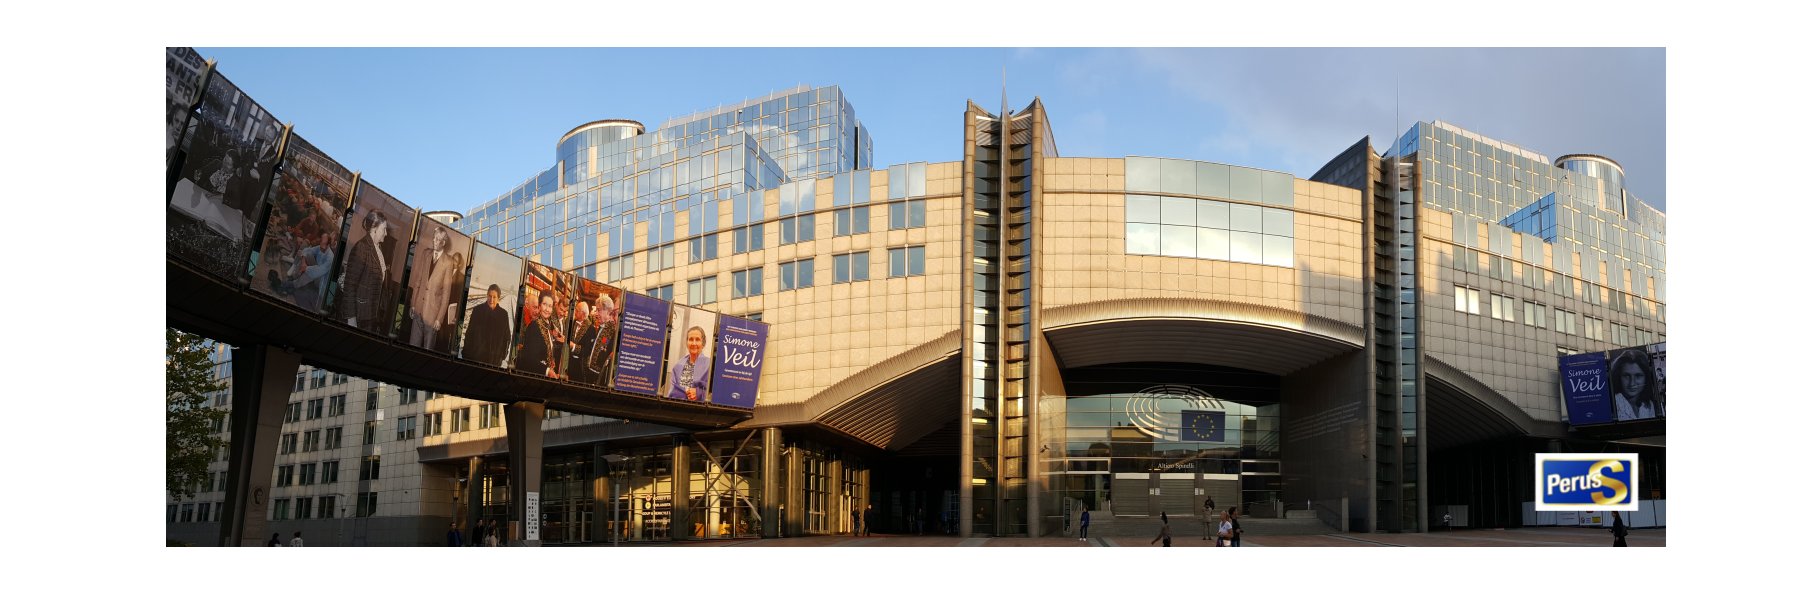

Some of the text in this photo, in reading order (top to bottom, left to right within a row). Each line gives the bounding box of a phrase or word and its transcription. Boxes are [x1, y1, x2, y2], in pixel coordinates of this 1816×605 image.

[175, 47, 201, 69] DES
[723, 334, 760, 349] Simone
[723, 345, 761, 369] Veil
[1568, 369, 1601, 378] Simone
[1569, 375, 1605, 392] Veil
